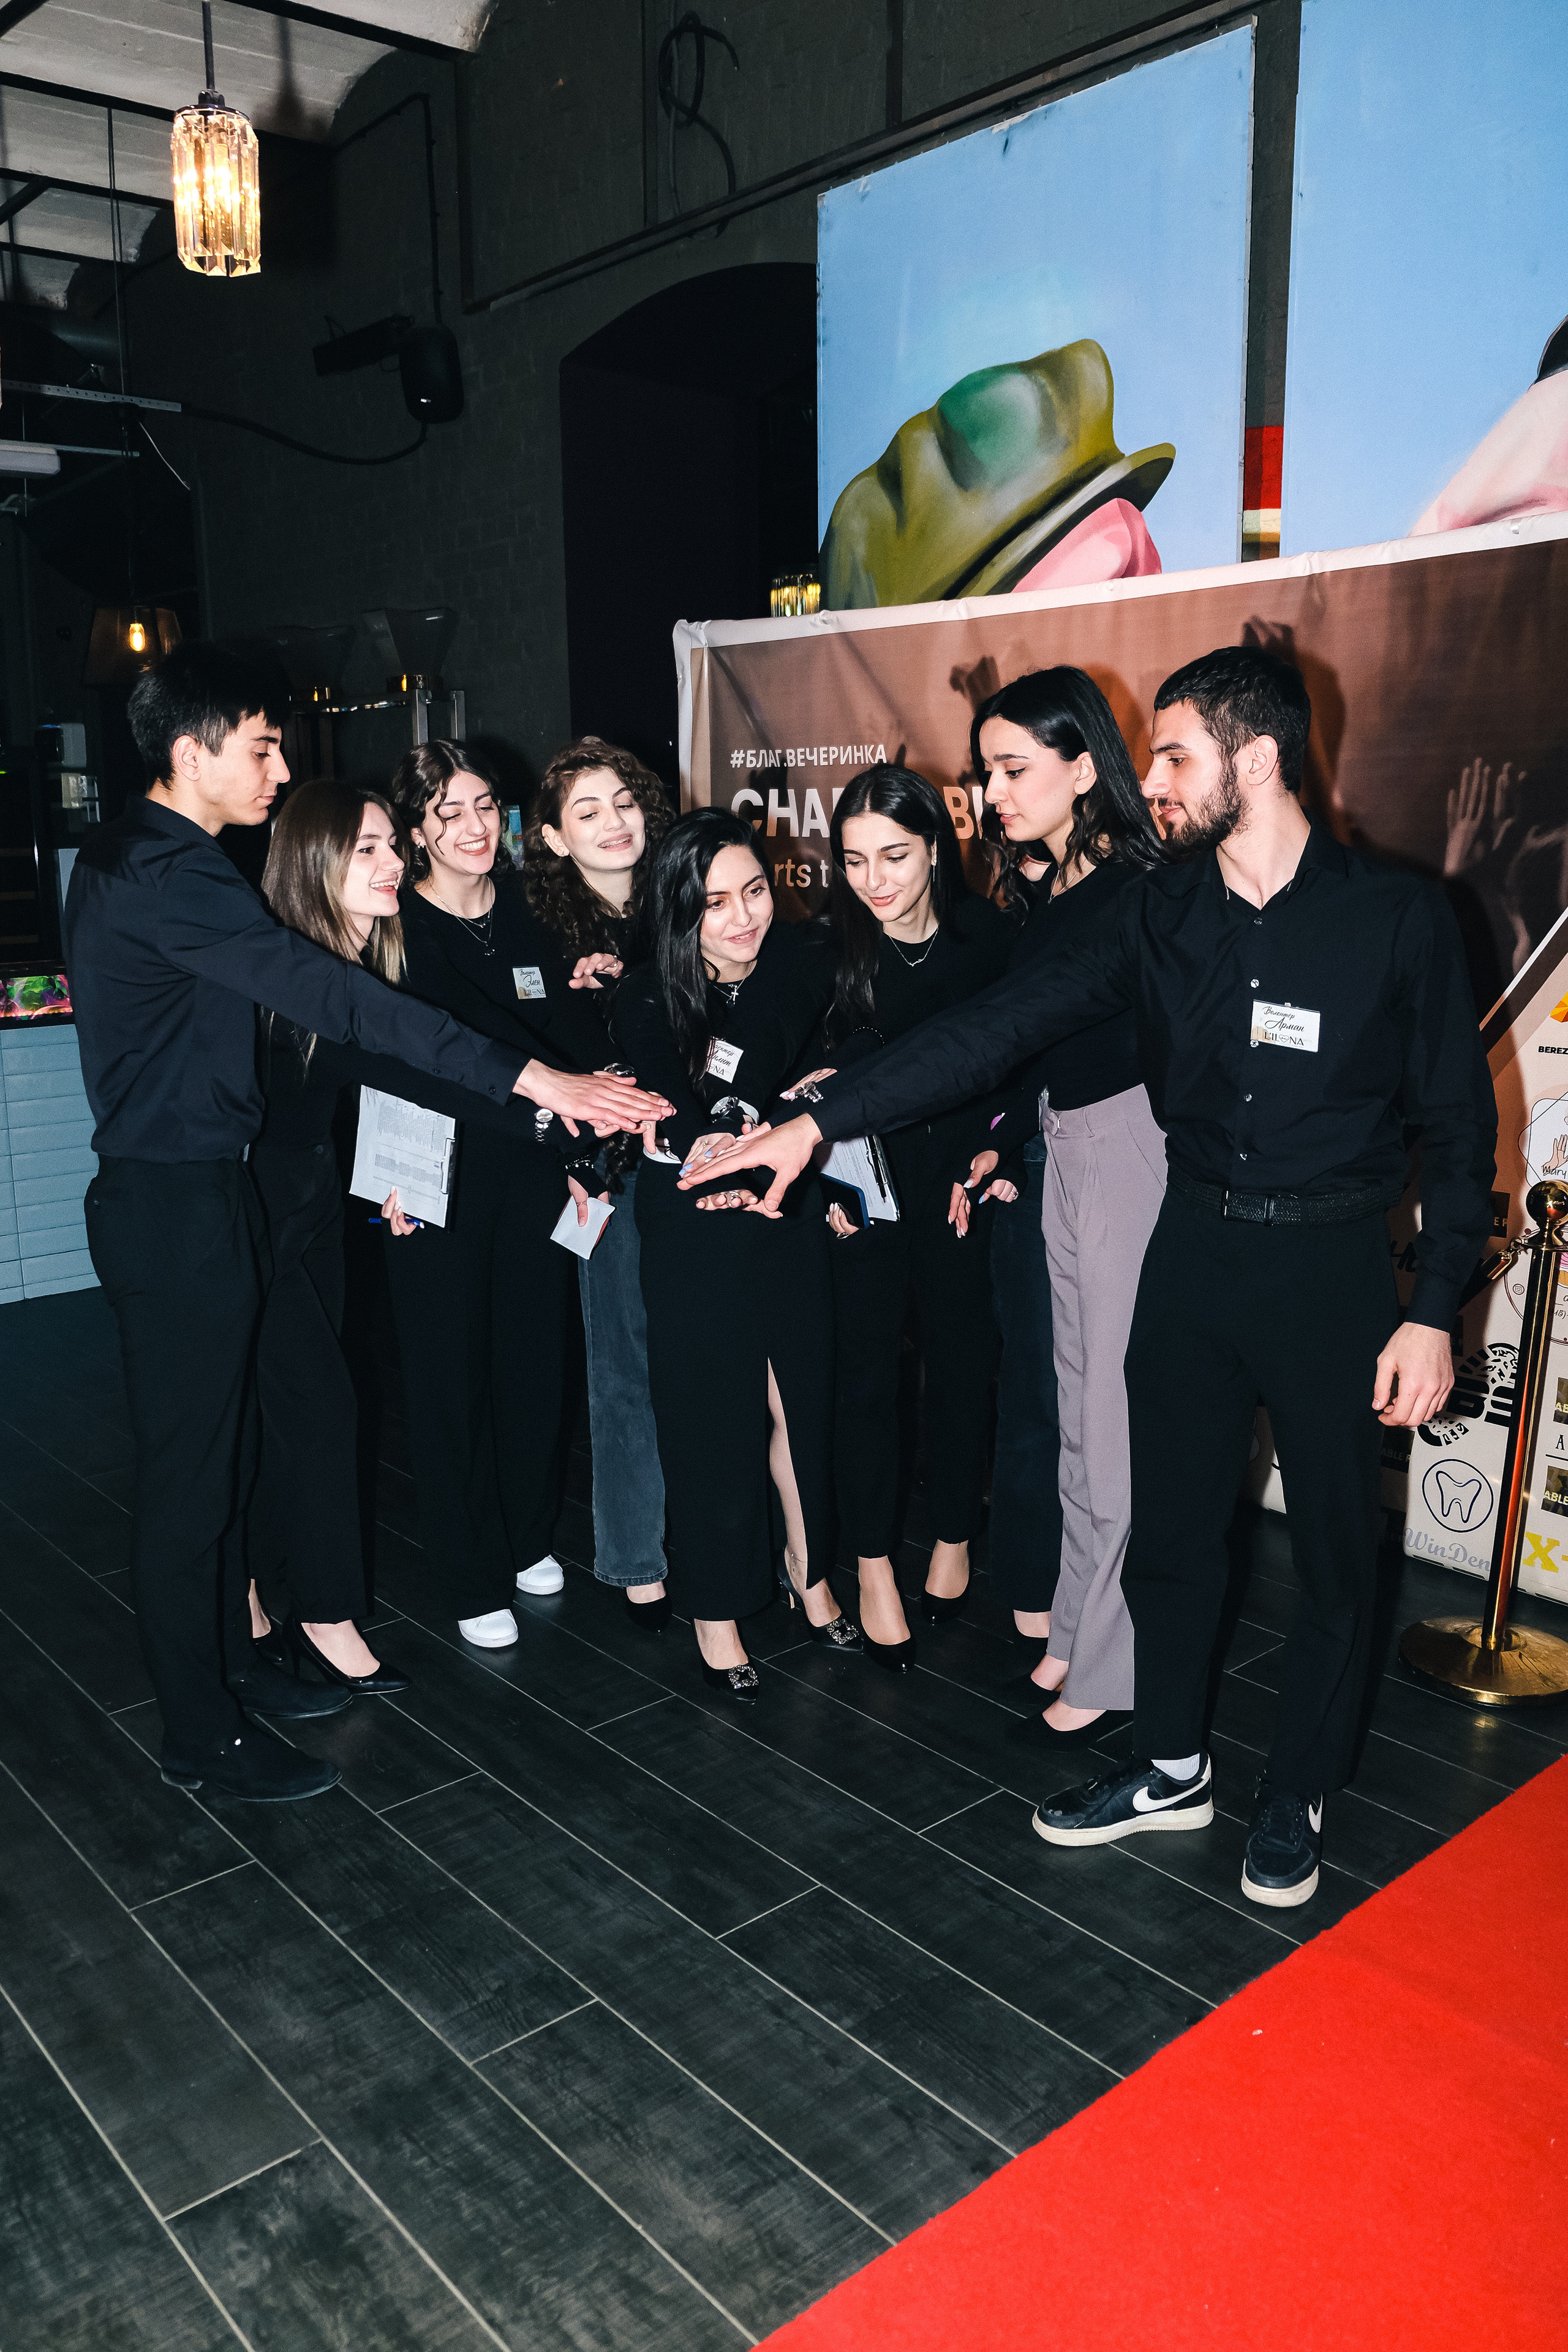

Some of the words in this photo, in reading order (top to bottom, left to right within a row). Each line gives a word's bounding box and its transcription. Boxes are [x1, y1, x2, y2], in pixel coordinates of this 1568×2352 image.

[730, 744, 888, 768] #БЛАГ.ВЕЧЕРИНКА
[731, 788, 845, 838] CHA
[774, 859, 812, 888] rts
[1264, 1017, 1305, 1032] Арман
[1538, 1046, 1568, 1055] BEREZ
[1542, 1165, 1567, 1179] Mary
[1544, 1490, 1568, 1506] ABLE
